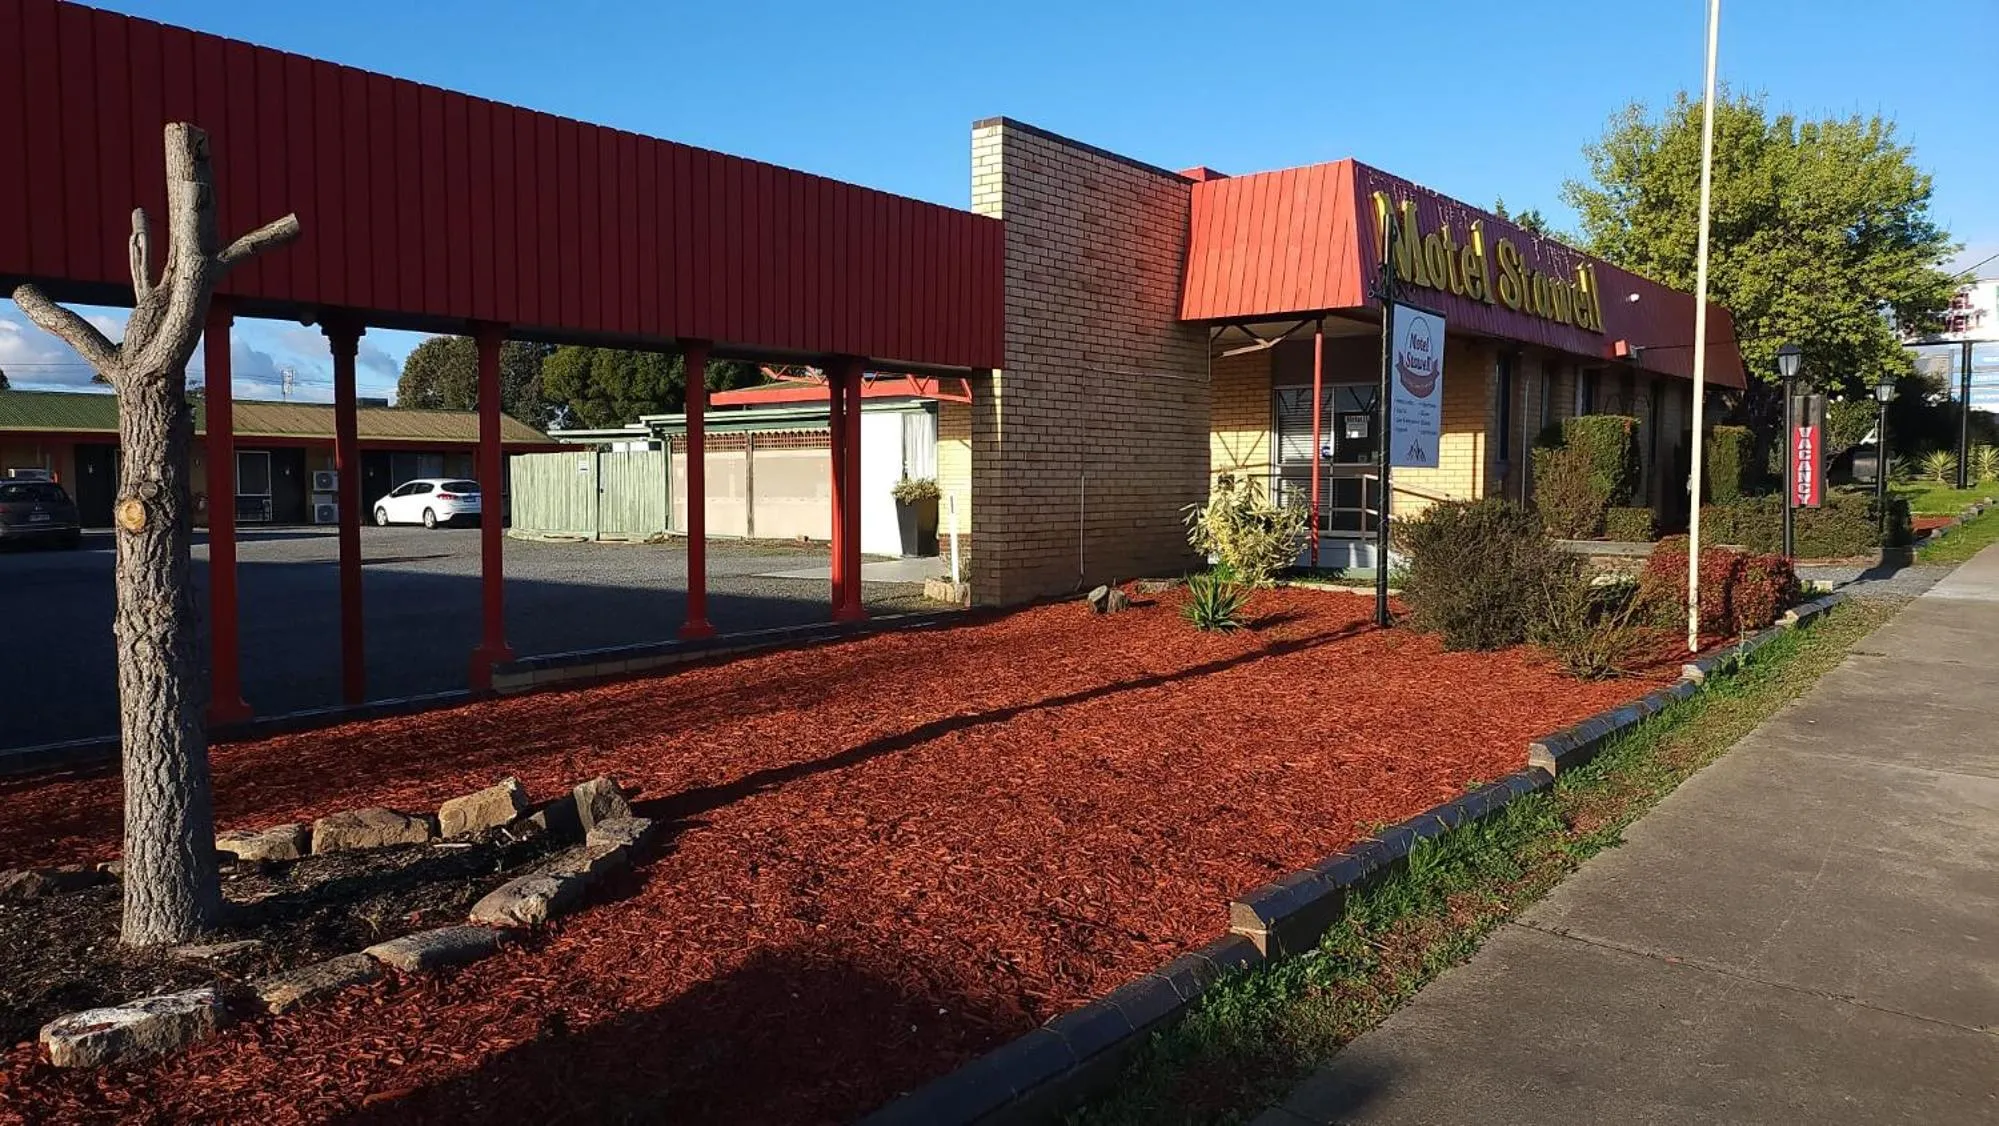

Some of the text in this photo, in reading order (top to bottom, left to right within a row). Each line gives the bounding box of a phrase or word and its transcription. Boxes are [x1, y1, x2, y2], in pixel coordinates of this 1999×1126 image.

[1373, 190, 1606, 333] Motel Stawell
[1409, 331, 1430, 353] Motel
[1797, 426, 1813, 505] VACANCY
